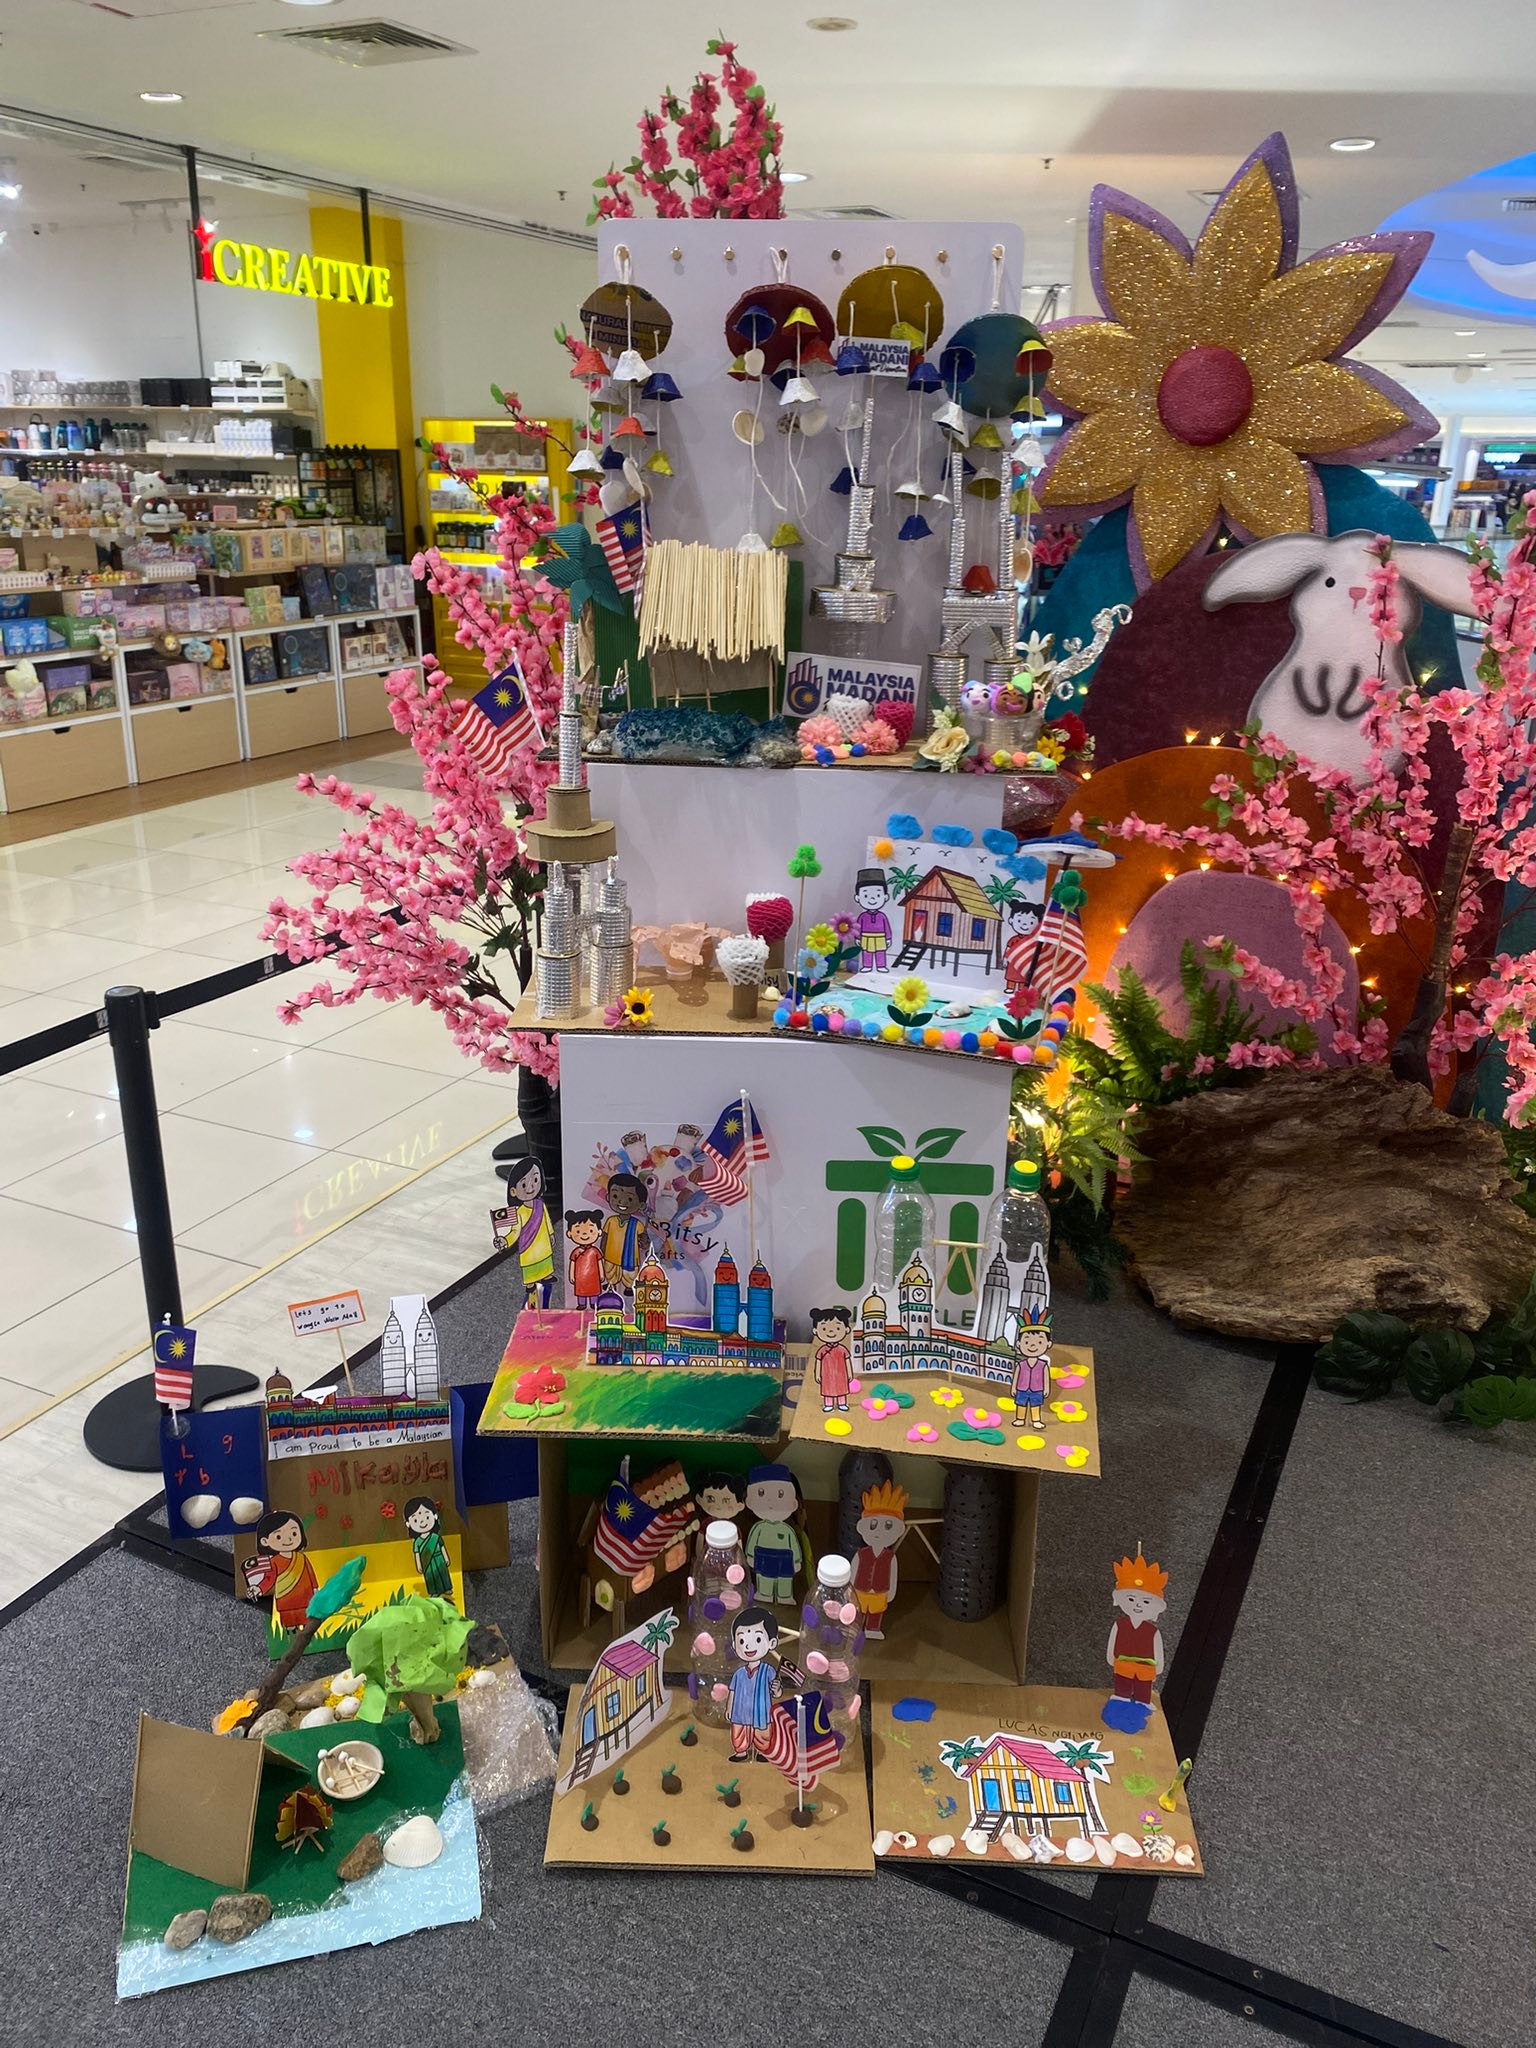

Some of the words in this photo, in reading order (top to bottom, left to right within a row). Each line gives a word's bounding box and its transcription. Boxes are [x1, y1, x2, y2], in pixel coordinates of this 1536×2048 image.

[860, 342, 909, 354] MALAYSIA
[827, 668, 915, 690] MALAYSIA
[273, 1442, 279, 1459] I
[285, 1445, 303, 1454] am
[352, 1437, 362, 1447] to
[368, 1435, 380, 1447] be
[396, 1430, 443, 1444] Malaysian
[998, 1718, 1050, 1738] LUCAS
